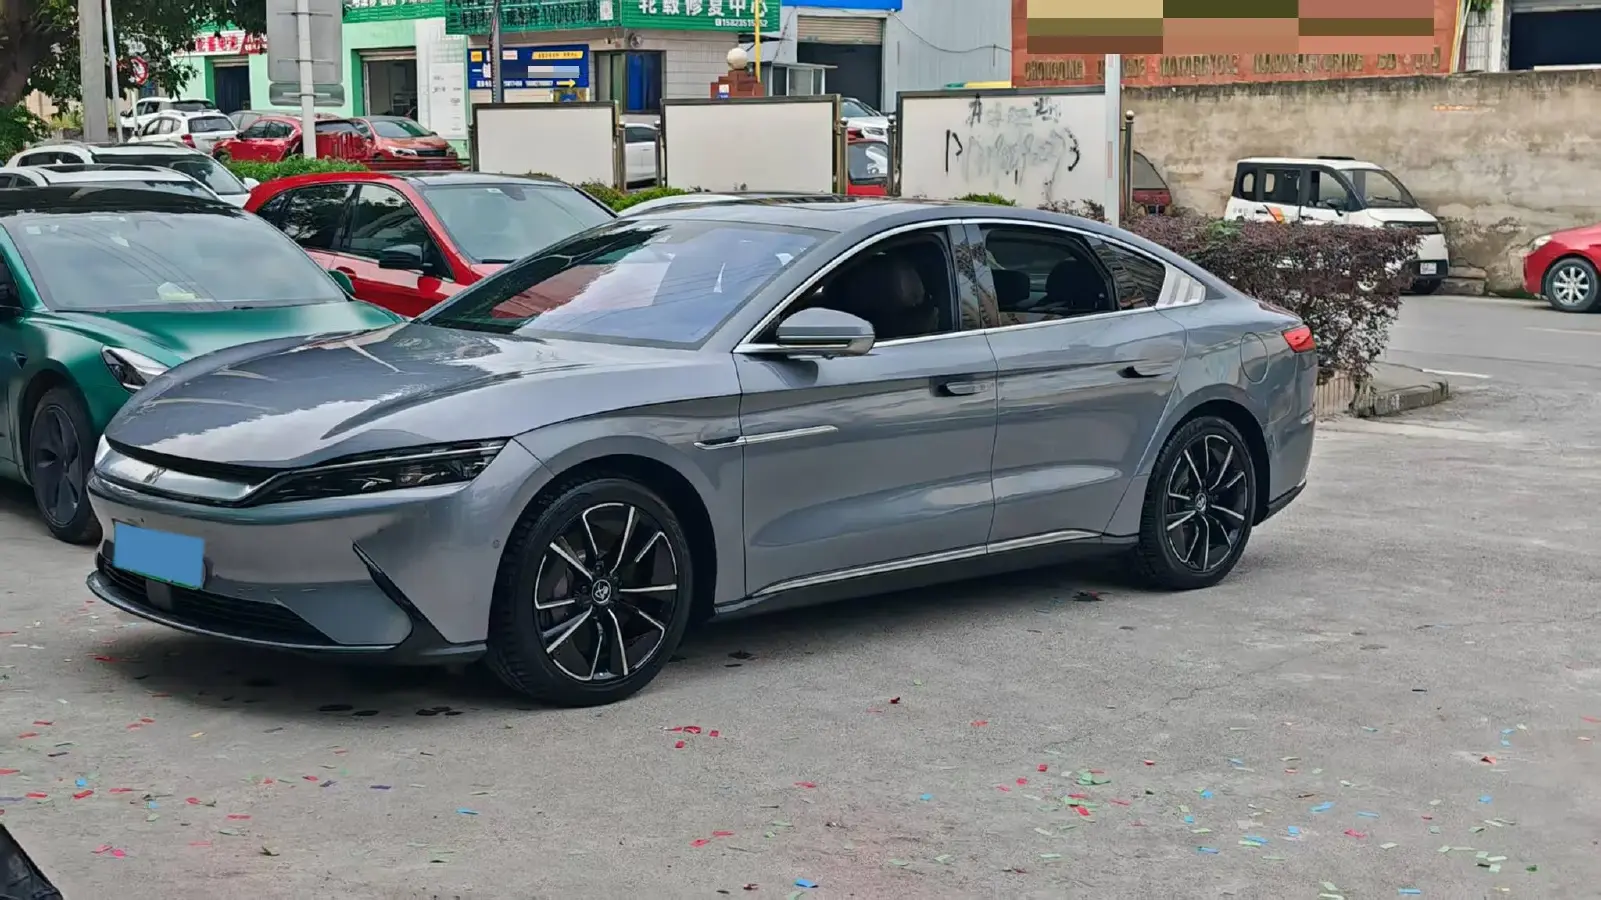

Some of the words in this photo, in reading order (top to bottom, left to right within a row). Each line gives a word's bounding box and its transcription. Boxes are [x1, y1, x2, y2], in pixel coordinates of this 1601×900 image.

[638, 0, 768, 17] 轮毂修复中心
[1160, 54, 1240, 77] MOTORCYCLE
